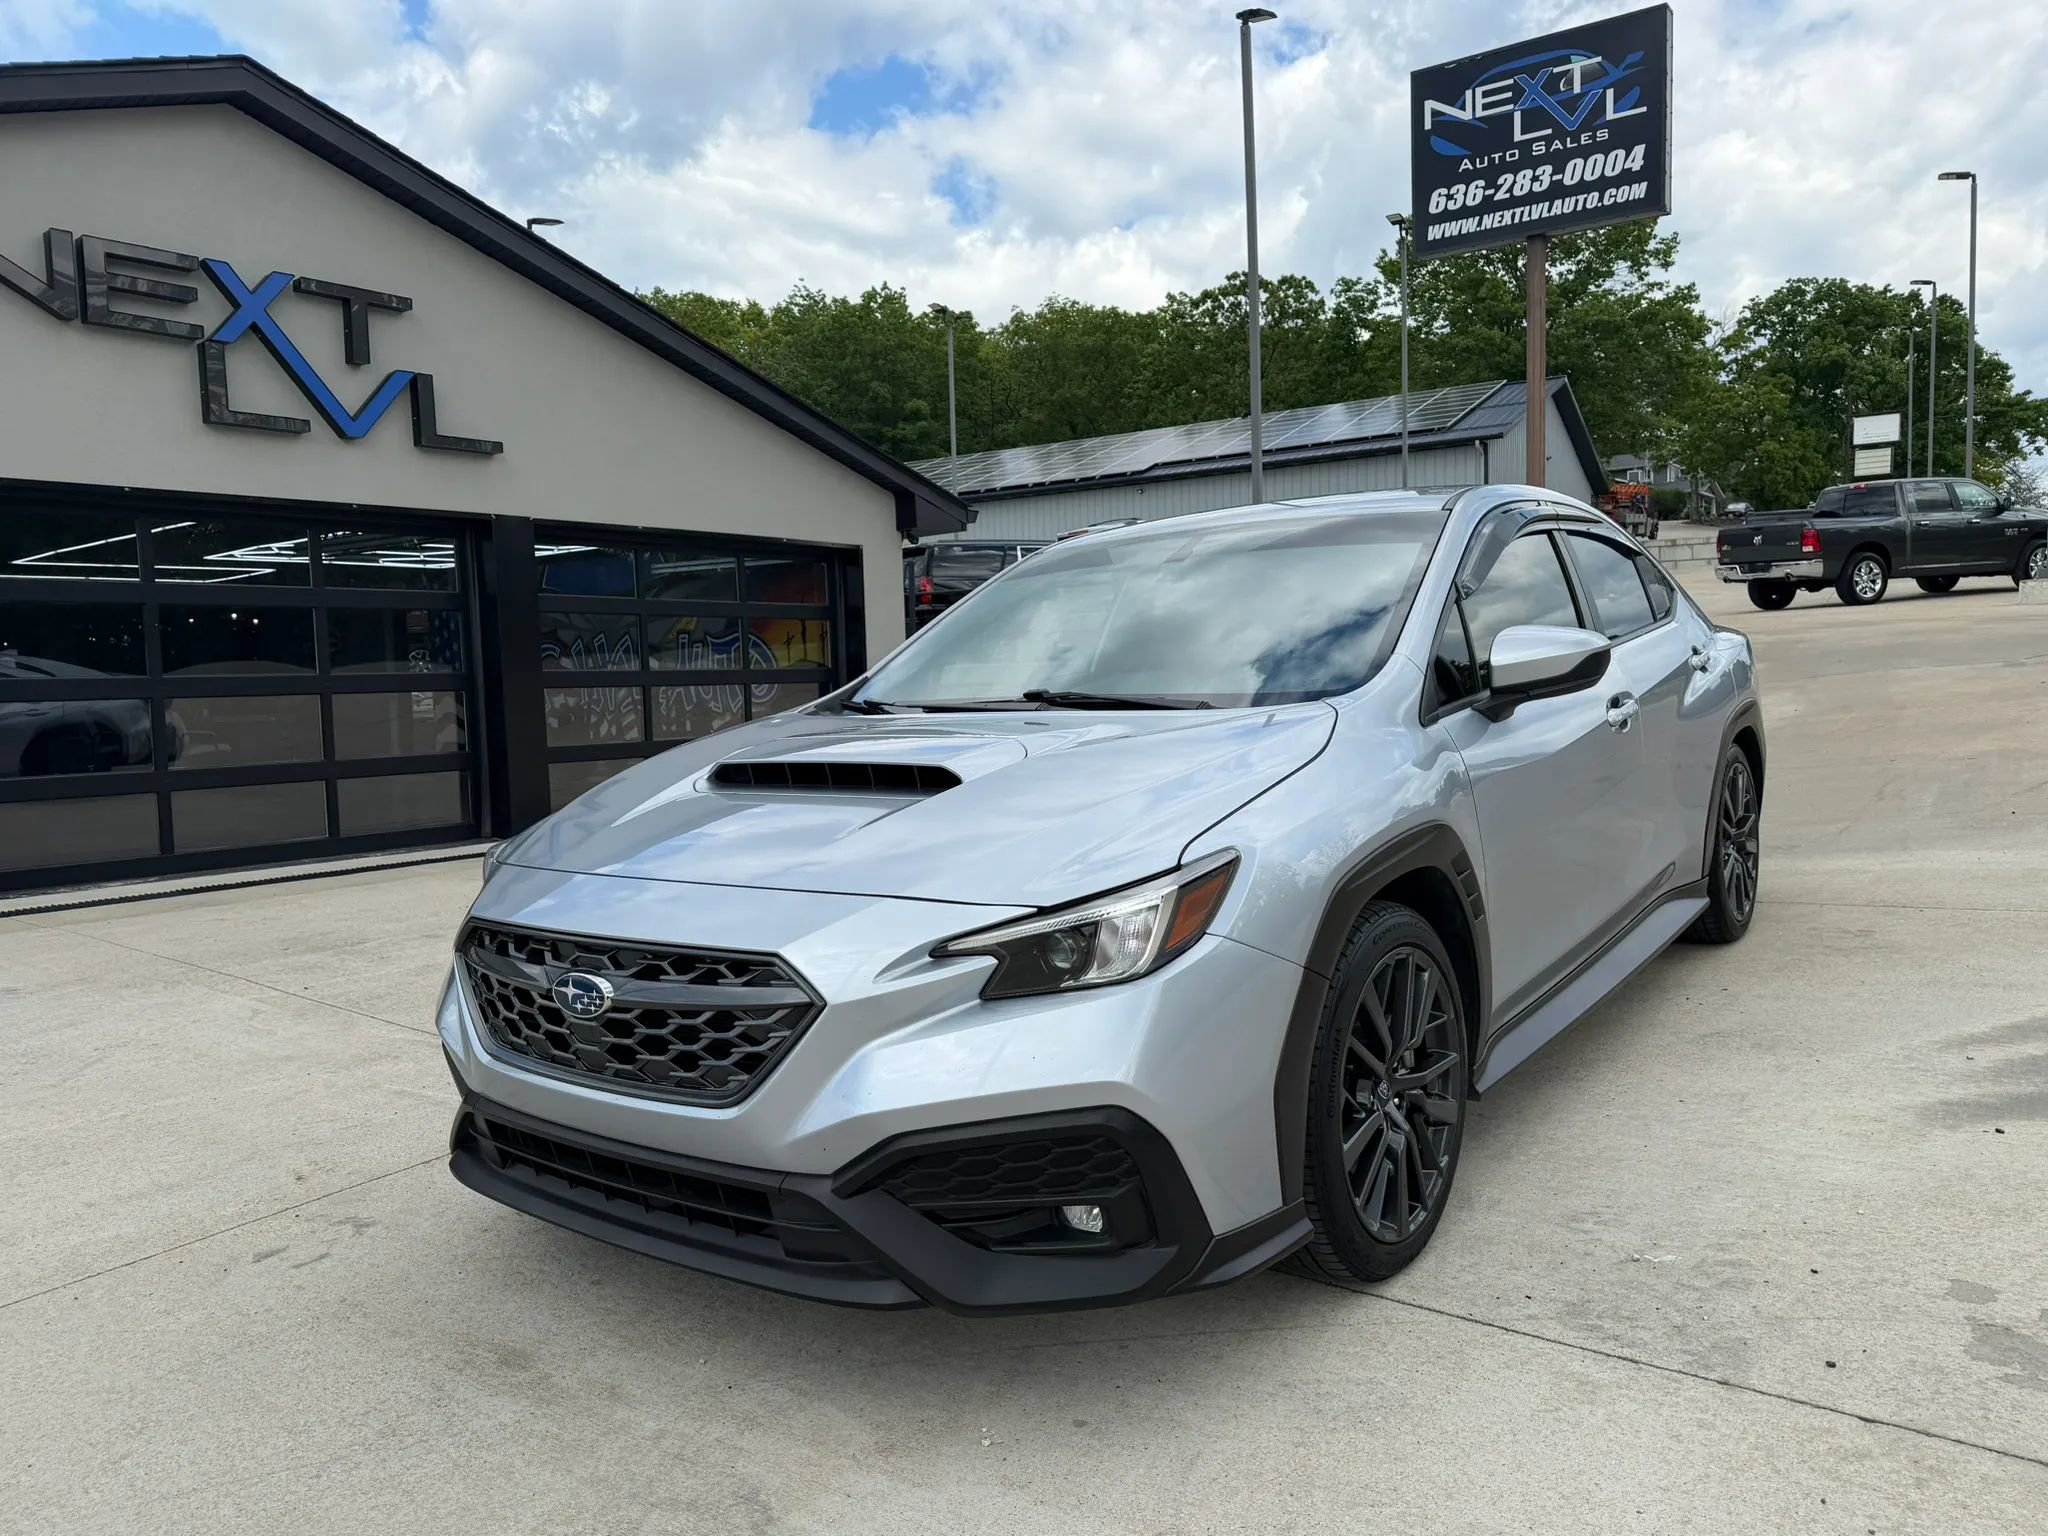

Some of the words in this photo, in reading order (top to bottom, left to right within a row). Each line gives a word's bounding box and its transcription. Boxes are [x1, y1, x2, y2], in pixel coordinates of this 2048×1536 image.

[1424, 56, 1602, 130] NEXT
[1514, 88, 1647, 142] LVL
[1428, 144, 1647, 215] 636-283-0004
[1458, 149, 1519, 172] AUTO
[1532, 129, 1609, 156] SALES
[1427, 181, 1648, 241] WWW.NEXTLVLAUTO.COM
[198, 340, 503, 454] LVL
